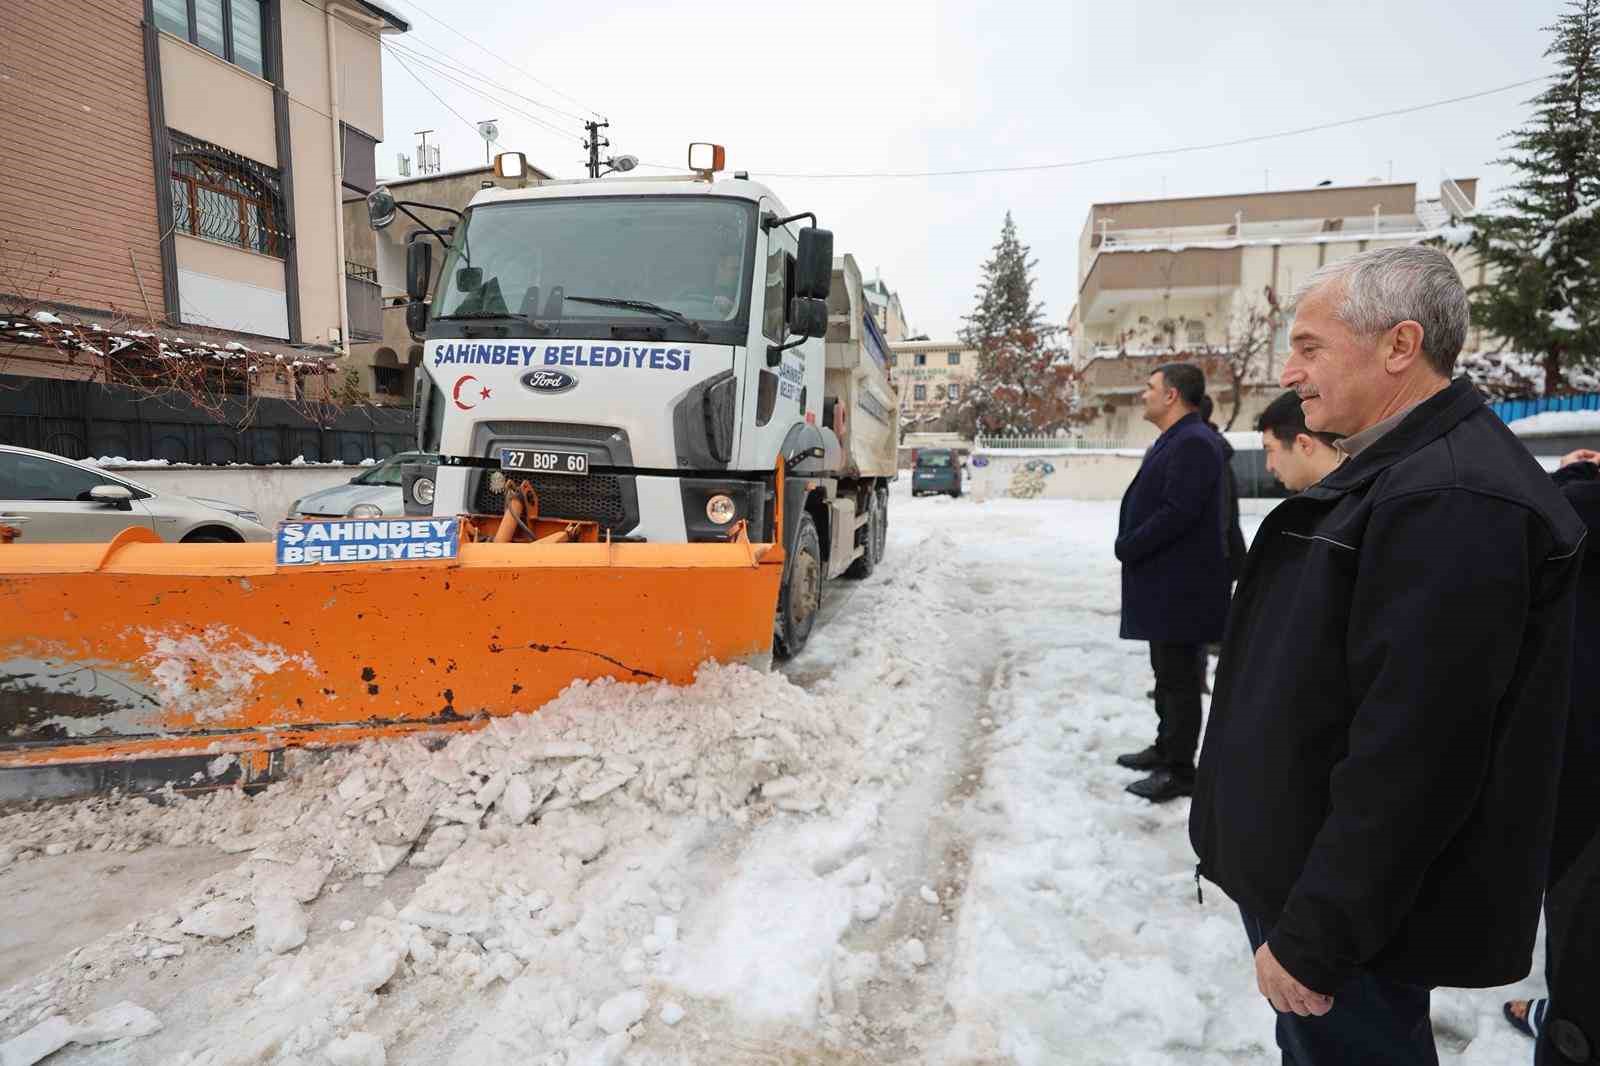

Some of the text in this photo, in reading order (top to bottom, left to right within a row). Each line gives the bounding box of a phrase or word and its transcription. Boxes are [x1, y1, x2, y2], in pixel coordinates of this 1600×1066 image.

[530, 371, 562, 386] Ford
[509, 452, 585, 471] 27 BOP 60
